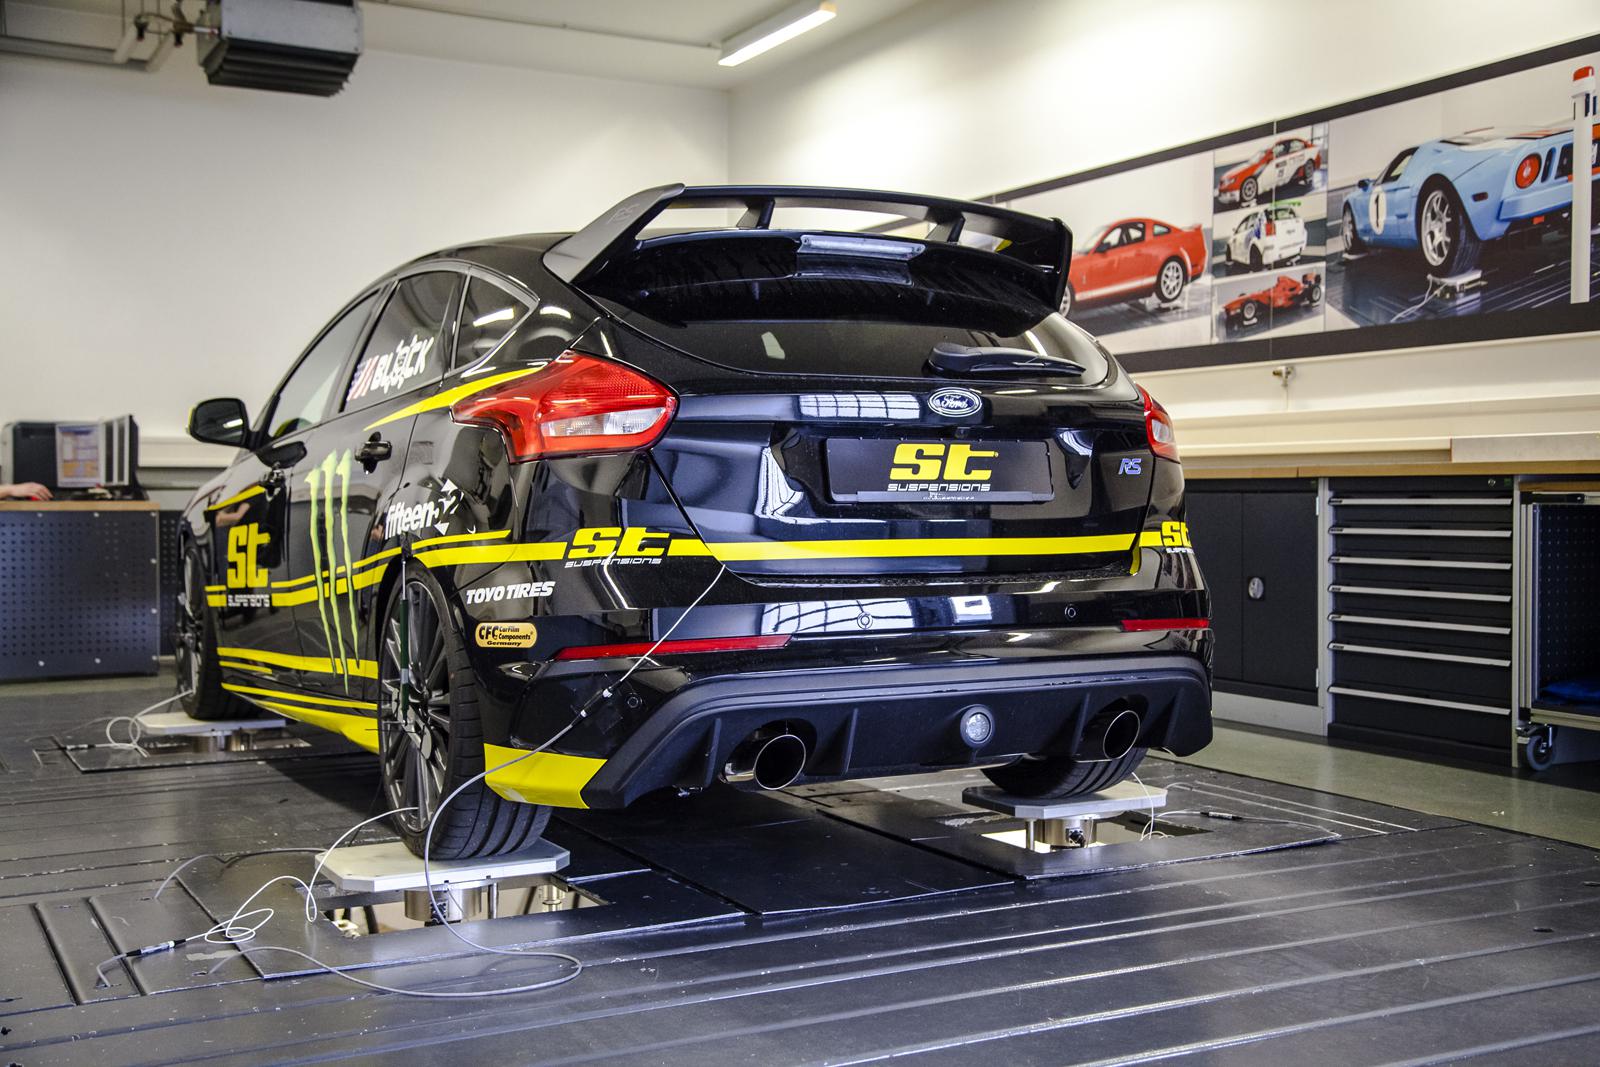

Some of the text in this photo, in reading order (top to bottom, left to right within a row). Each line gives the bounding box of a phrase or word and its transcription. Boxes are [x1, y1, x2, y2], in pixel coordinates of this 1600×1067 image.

[1118, 458, 1142, 475] RS
[887, 483, 992, 492] SUSPENSIONS
[466, 581, 556, 605] TOYO TIRES
[479, 625, 499, 640] CFC
[498, 633, 531, 641] Components
